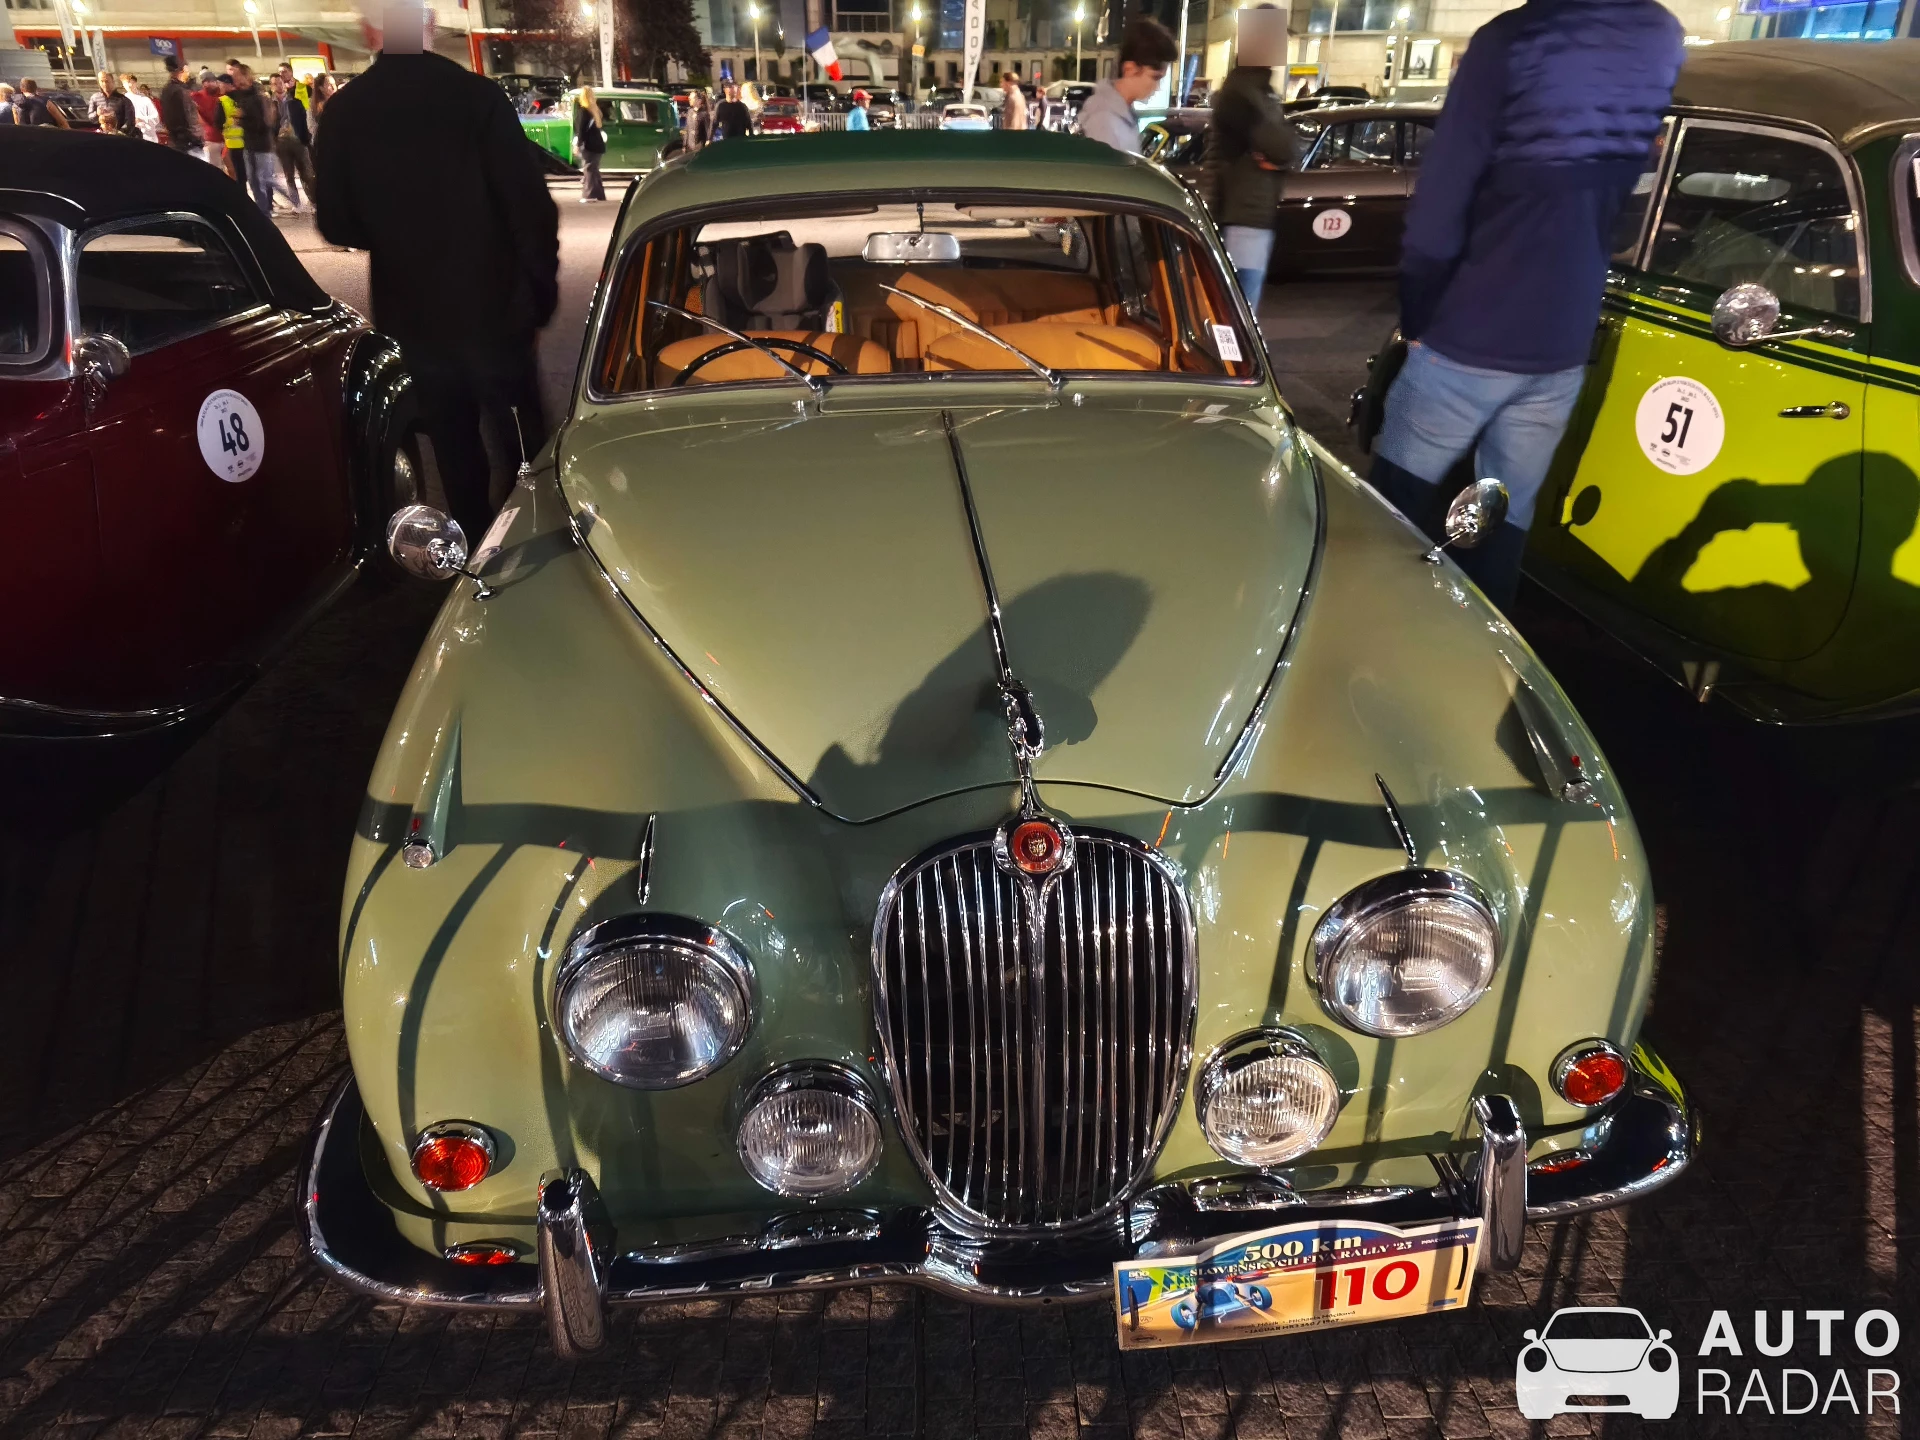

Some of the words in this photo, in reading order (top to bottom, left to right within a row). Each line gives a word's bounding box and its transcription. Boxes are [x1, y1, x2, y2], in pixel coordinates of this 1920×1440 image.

[1323, 217, 1341, 231] 123
[219, 412, 250, 456] 48
[1661, 401, 1694, 449] 51
[1243, 1240, 1304, 1262] 500
[1311, 1234, 1363, 1254] km
[1303, 1250, 1338, 1265] FIVA
[1340, 1244, 1390, 1260] RALLY
[1315, 1260, 1420, 1310] 110
[1249, 1326, 1281, 1334] JAGUAR
